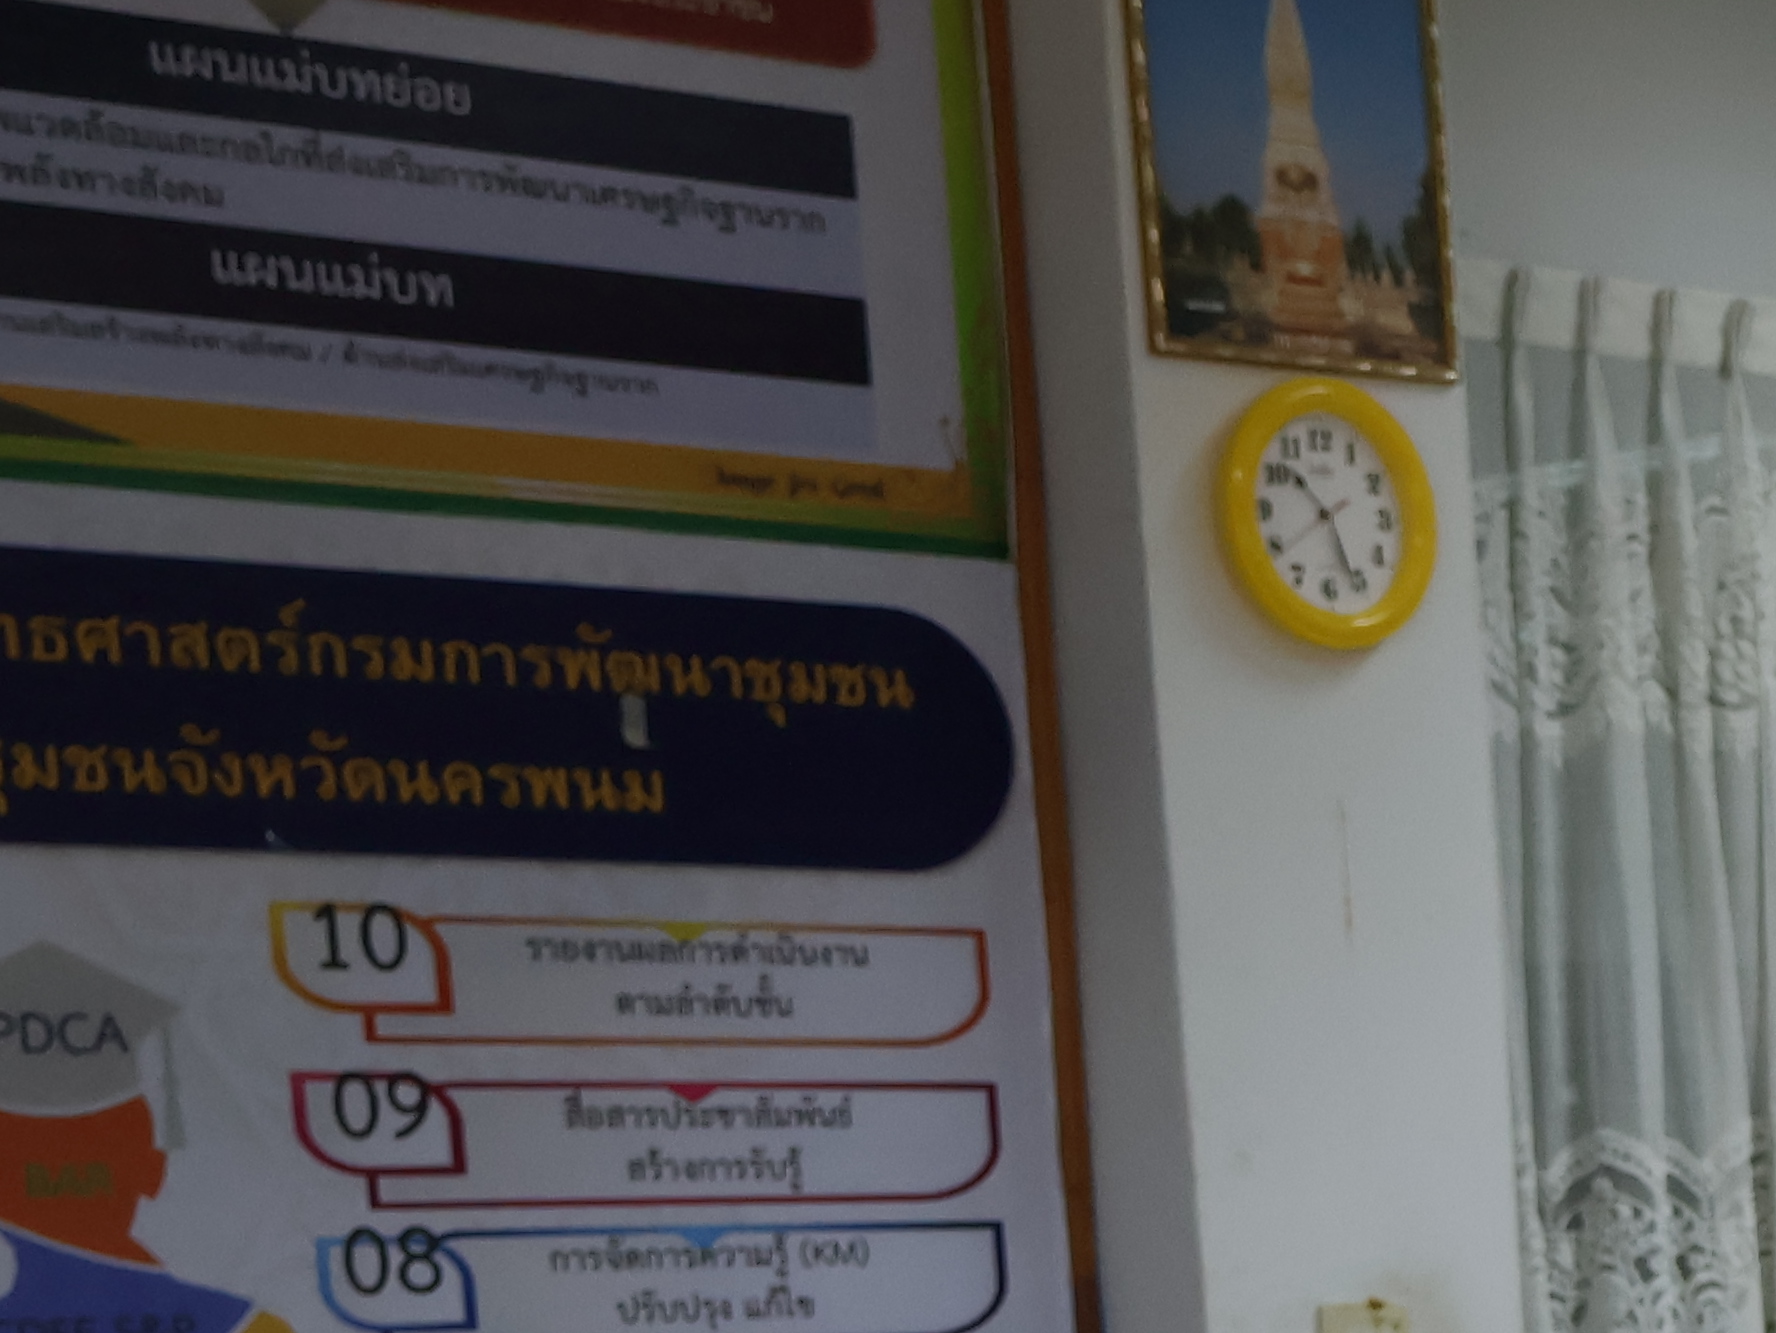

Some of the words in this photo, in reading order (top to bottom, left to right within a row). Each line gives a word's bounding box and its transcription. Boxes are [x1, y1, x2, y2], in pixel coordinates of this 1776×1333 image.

[147, 37, 472, 117] แผนแม่บทย่อย
[209, 246, 456, 311] แผนแม่บท
[0, 720, 669, 817] มชนจังหวัดนครพนม
[310, 904, 410, 972] 10
[332, 1071, 431, 1140] 09
[343, 1227, 445, 1296] 08
[799, 1239, 871, 1273] (KM)
